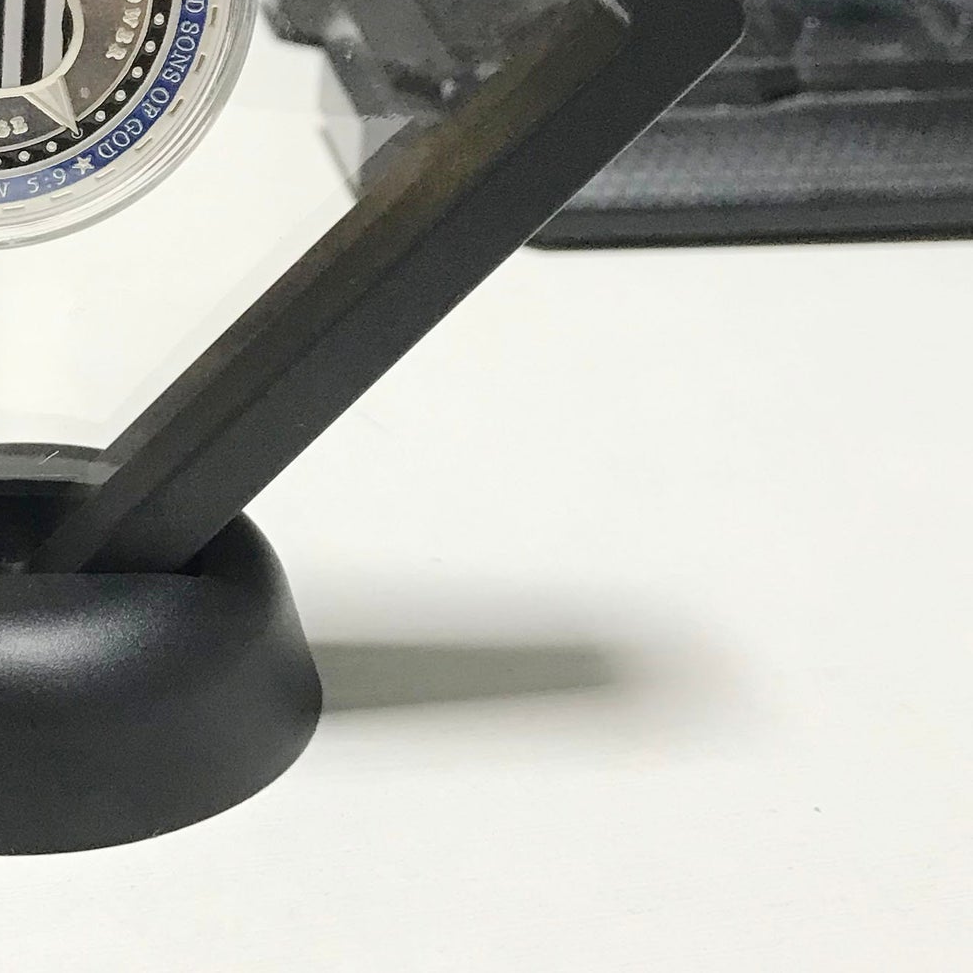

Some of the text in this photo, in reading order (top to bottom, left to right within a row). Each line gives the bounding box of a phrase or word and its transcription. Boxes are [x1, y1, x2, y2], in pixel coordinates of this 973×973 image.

[161, 20, 200, 83] SONS
[98, 118, 143, 159] GOD
[27, 168, 67, 193] 5:9
